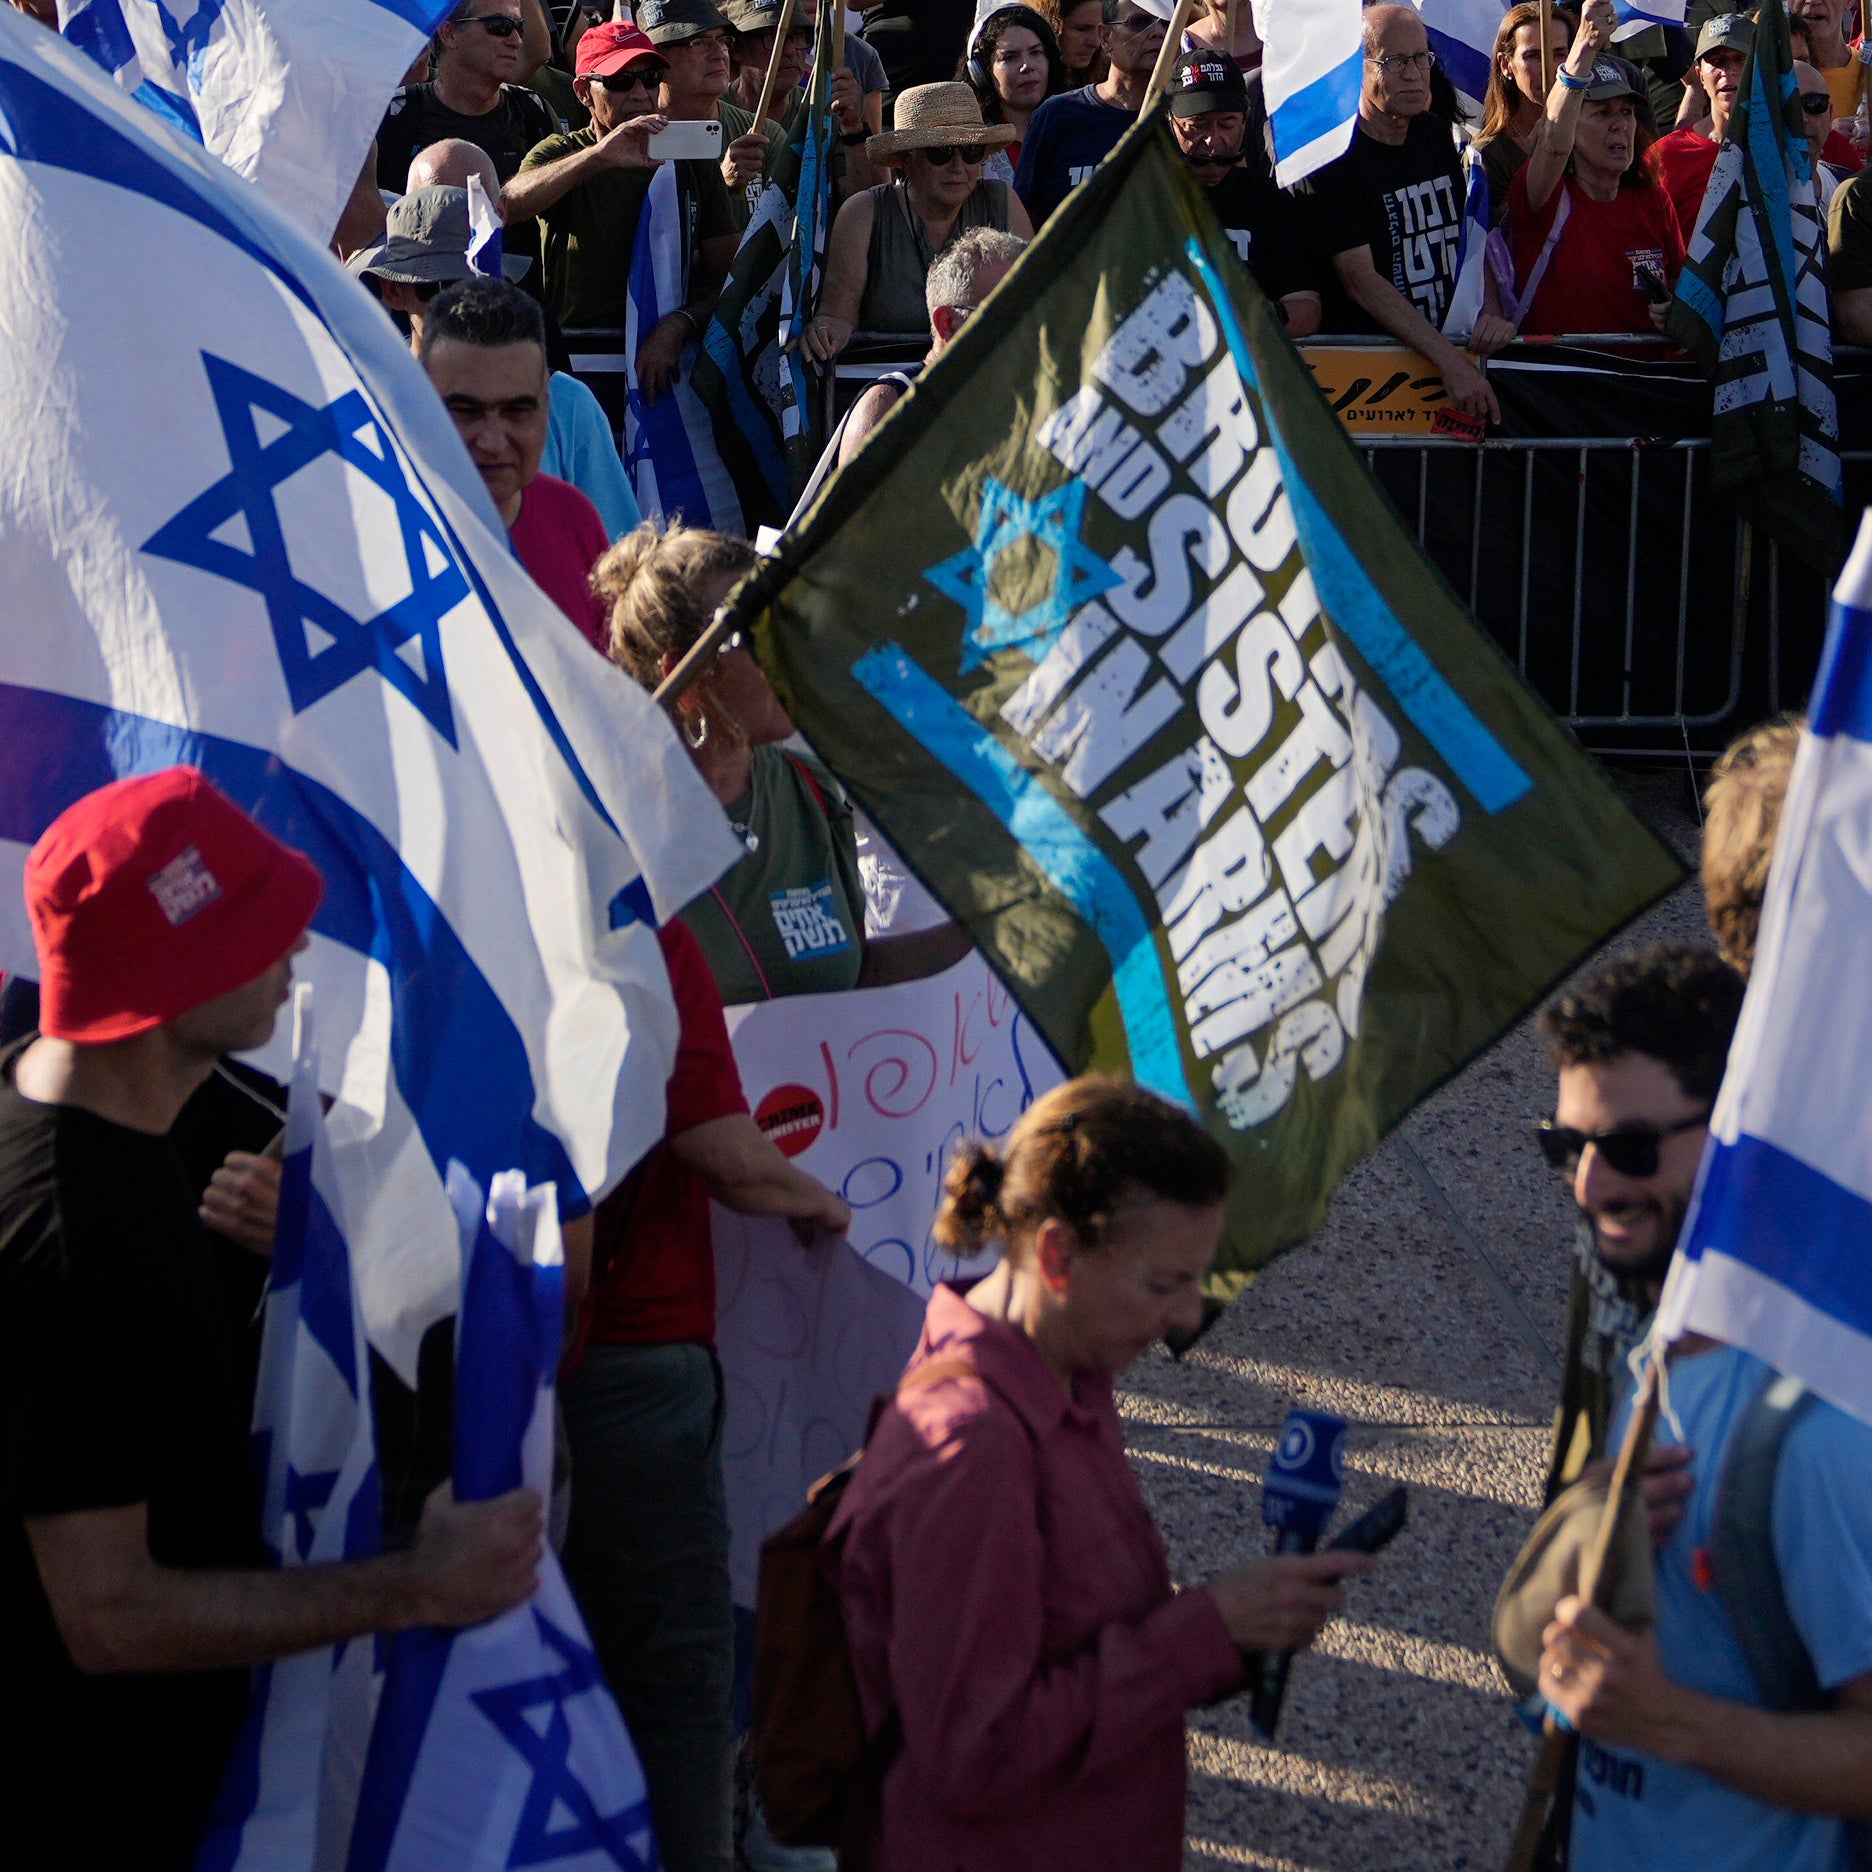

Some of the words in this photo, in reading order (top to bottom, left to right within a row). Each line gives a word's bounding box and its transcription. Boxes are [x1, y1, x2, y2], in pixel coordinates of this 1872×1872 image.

[1394, 174, 1458, 235] דמו
[1035, 385, 1173, 523] AND
[1345, 408, 1416, 422] לארועים
[999, 598, 1188, 800] IN
[1098, 735, 1347, 1130] ARMS
